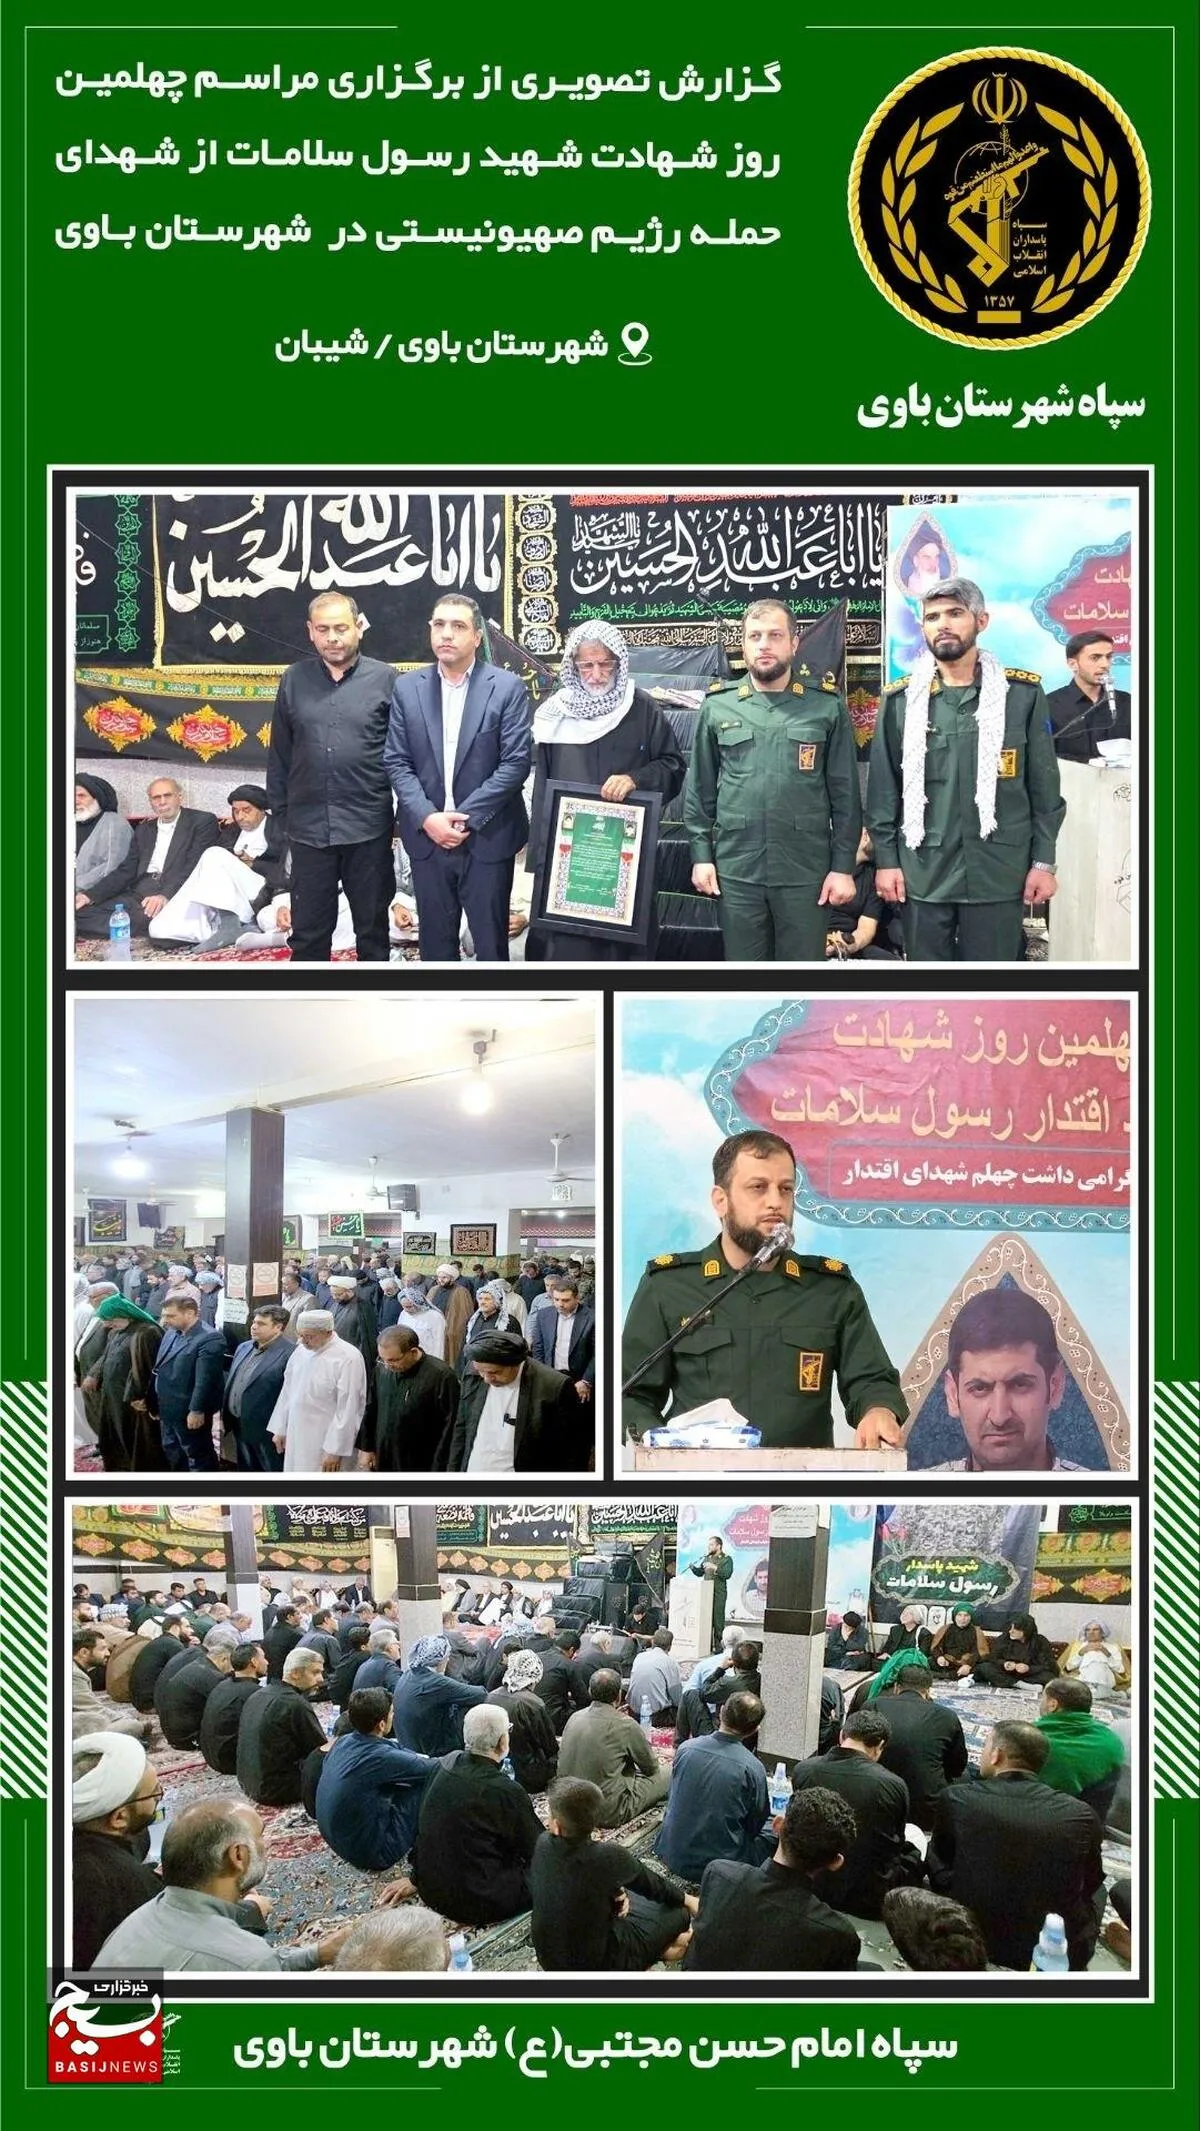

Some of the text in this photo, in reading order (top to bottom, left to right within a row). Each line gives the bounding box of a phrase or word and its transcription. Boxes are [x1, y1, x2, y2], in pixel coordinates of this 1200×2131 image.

[832, 1008, 1130, 1073] هلمین روز شهادت
[770, 1082, 1110, 1143] اقتدار رسول سلامات
[842, 1158, 899, 1186] اقتدار
[902, 1160, 968, 1187] شهدای
[971, 1162, 1019, 1189] چهلم
[1022, 1164, 1074, 1186] داشت
[906, 1559, 979, 1574] شهید پاسدار
[886, 1574, 999, 1597] رسول سلامات
